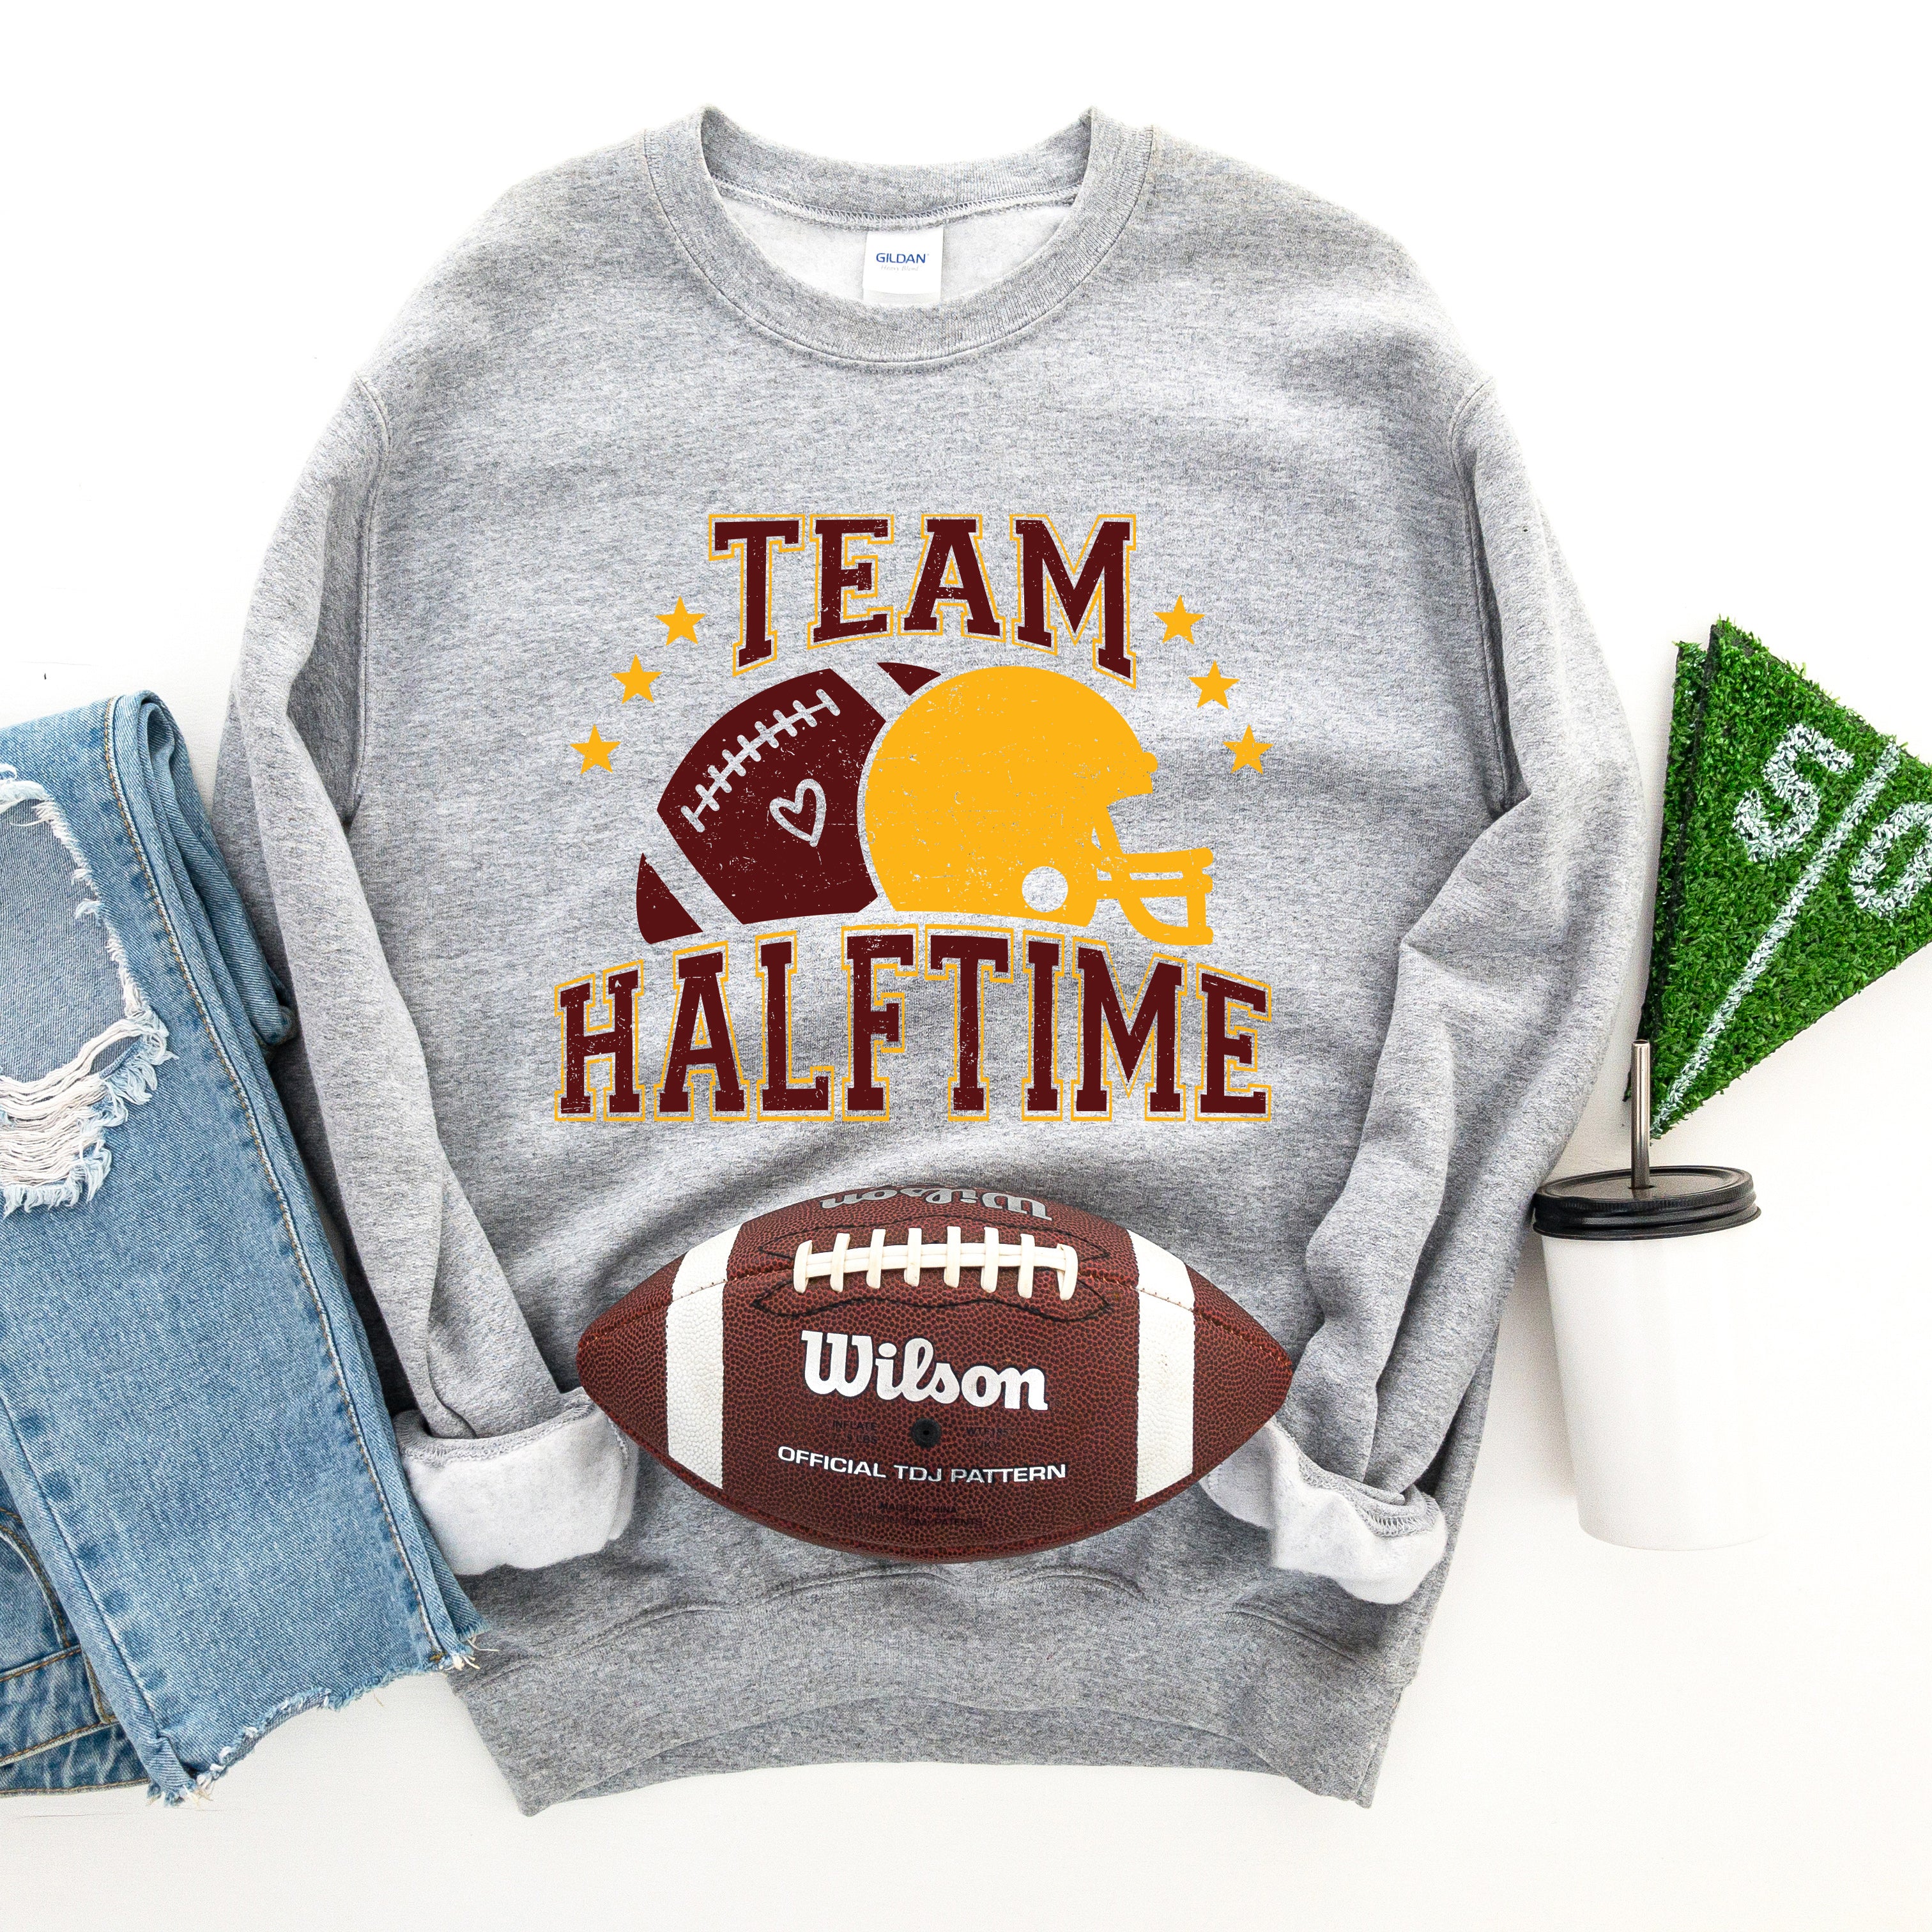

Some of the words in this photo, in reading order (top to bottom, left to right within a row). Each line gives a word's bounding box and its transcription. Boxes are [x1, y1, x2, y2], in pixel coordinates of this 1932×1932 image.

[876, 252, 926, 264] GILDAN
[709, 514, 1137, 689] TEAM
[554, 924, 1272, 1123] HALFTIME
[820, 1186, 1052, 1221] Wilson
[801, 1330, 1048, 1411] Wilson
[832, 1420, 878, 1432] INFLATE
[778, 1445, 887, 1478] OFFICIAL
[894, 1464, 942, 1483] TDJ
[951, 1464, 1066, 1483] PATTERN
[925, 1505, 958, 1514] CHINA
